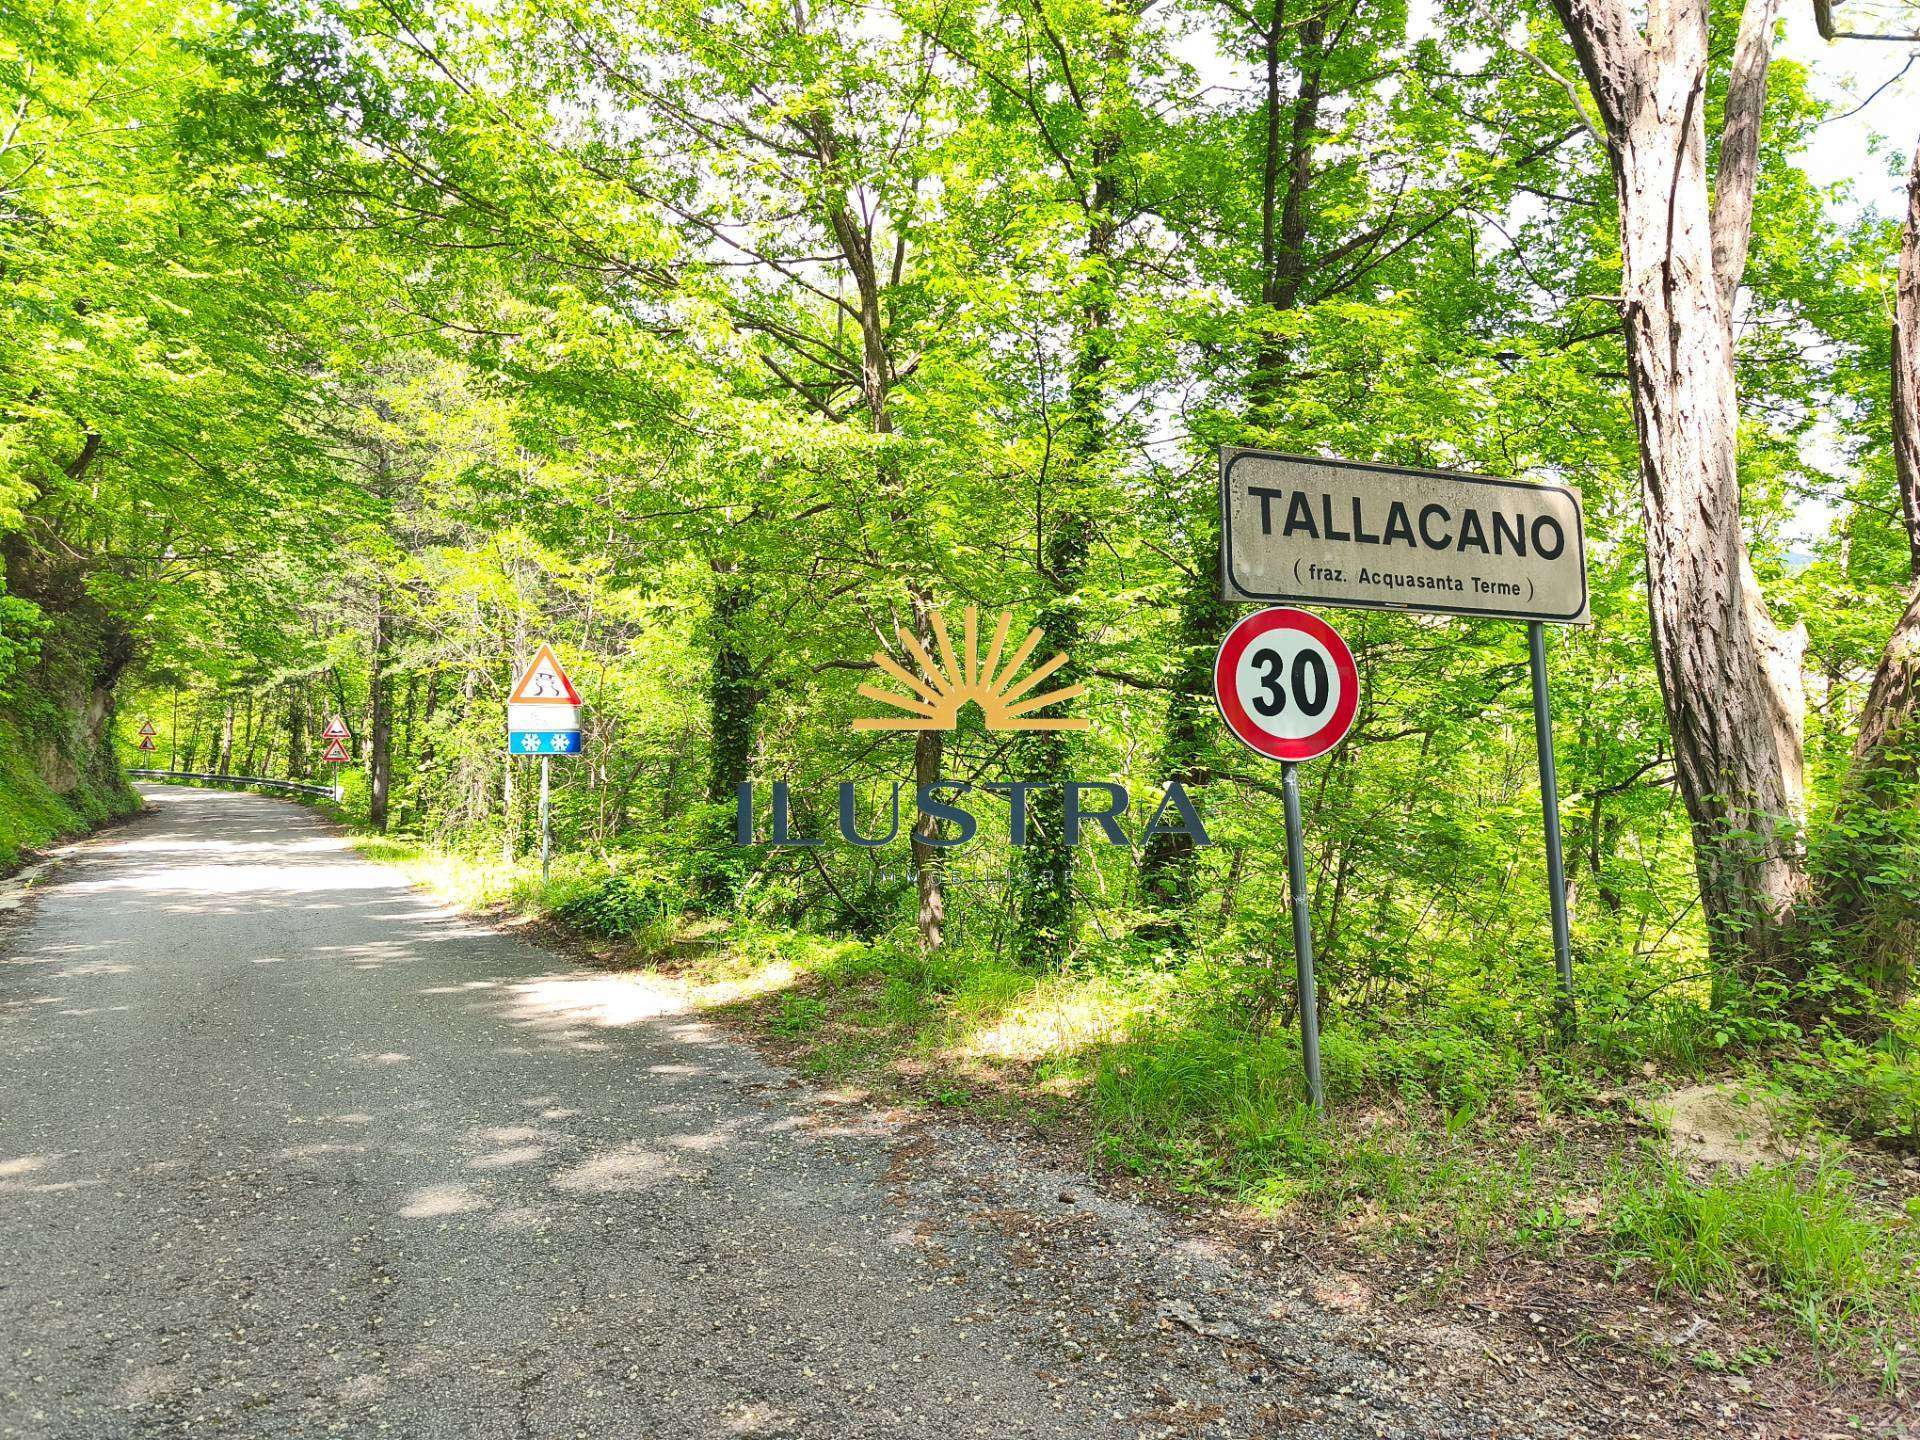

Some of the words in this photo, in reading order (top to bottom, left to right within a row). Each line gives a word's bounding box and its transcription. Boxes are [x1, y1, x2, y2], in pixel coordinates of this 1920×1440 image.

[1247, 486, 1565, 561] TALLACANO
[1359, 567, 1464, 591] Acquasanta
[1250, 648, 1329, 717] 30
